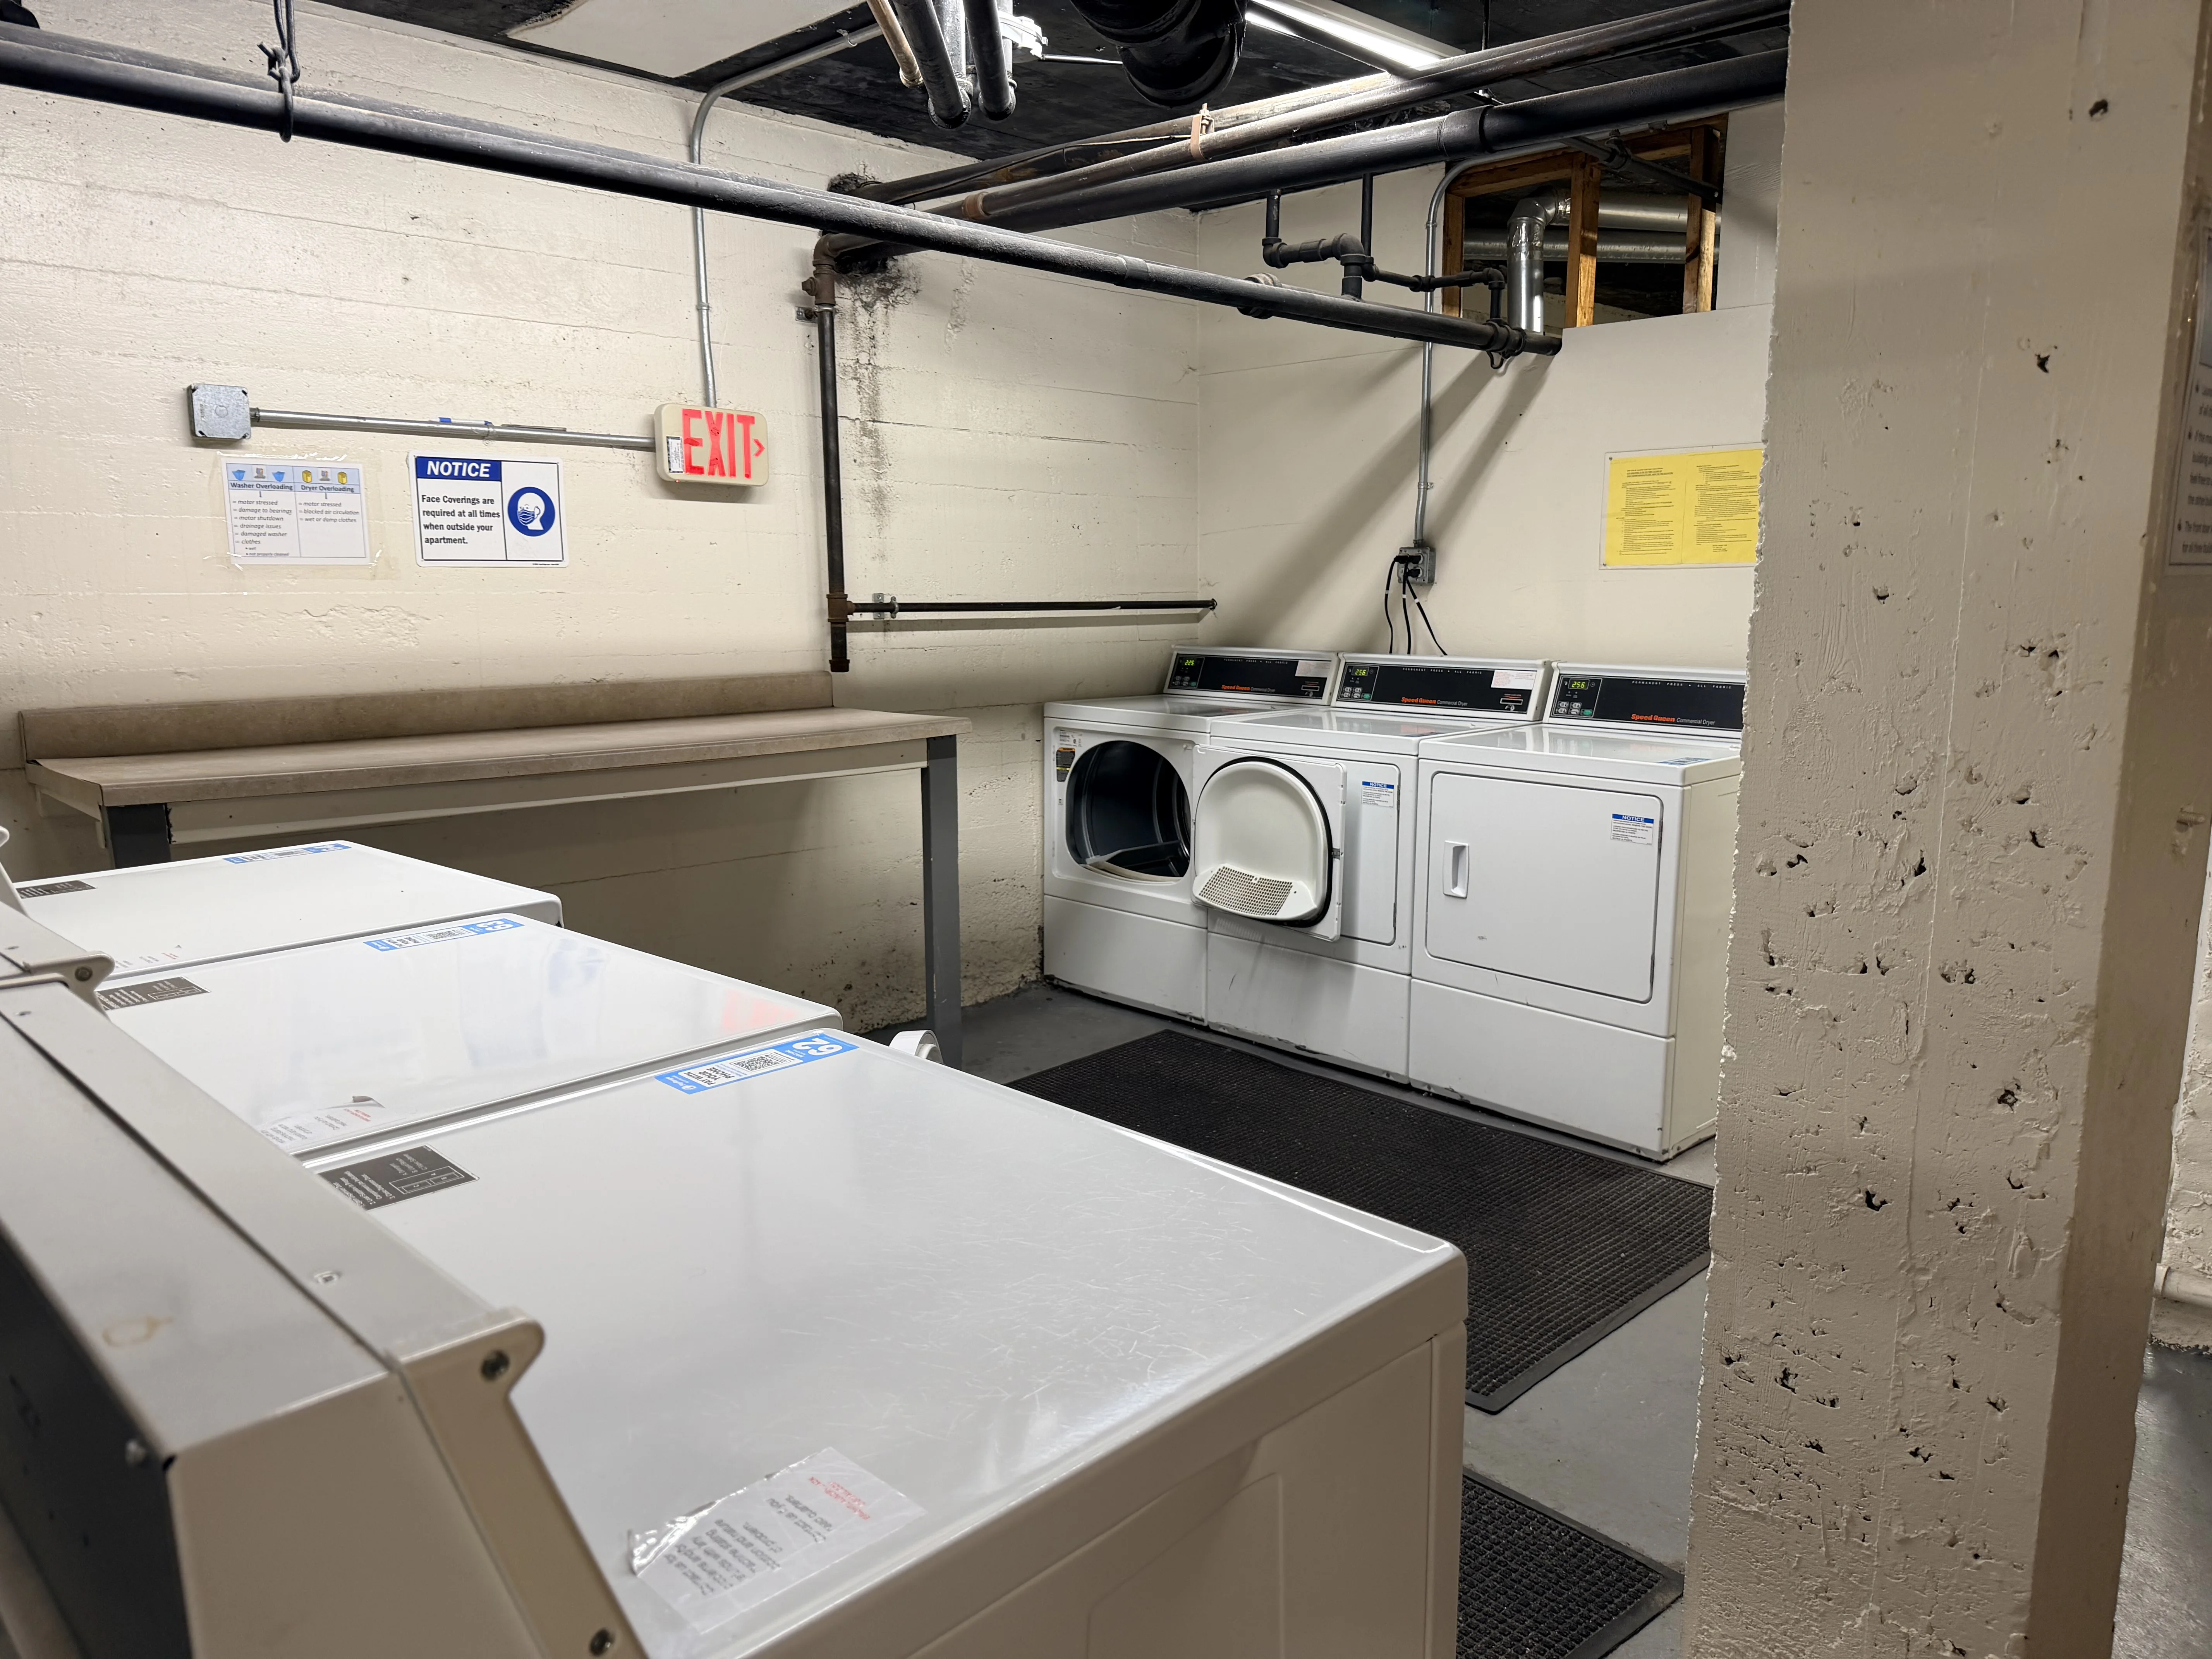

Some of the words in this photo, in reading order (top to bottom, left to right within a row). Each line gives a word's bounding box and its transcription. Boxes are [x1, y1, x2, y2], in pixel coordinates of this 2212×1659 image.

[682, 408, 752, 479] EXIT
[427, 461, 491, 478] NOTICE
[443, 495, 480, 505] Coverings
[425, 537, 468, 545] apartment.
[476, 921, 513, 931] 63
[792, 1038, 842, 1055] 62
[698, 1071, 720, 1080] YOUR
[706, 1067, 735, 1079] PHONE
[768, 1498, 785, 1509] you
[794, 1519, 826, 1542] Contact
[735, 1536, 754, 1548] and
[664, 1554, 677, 1564] for
[698, 1561, 733, 1588] problems
[682, 1569, 714, 1595] Contact
